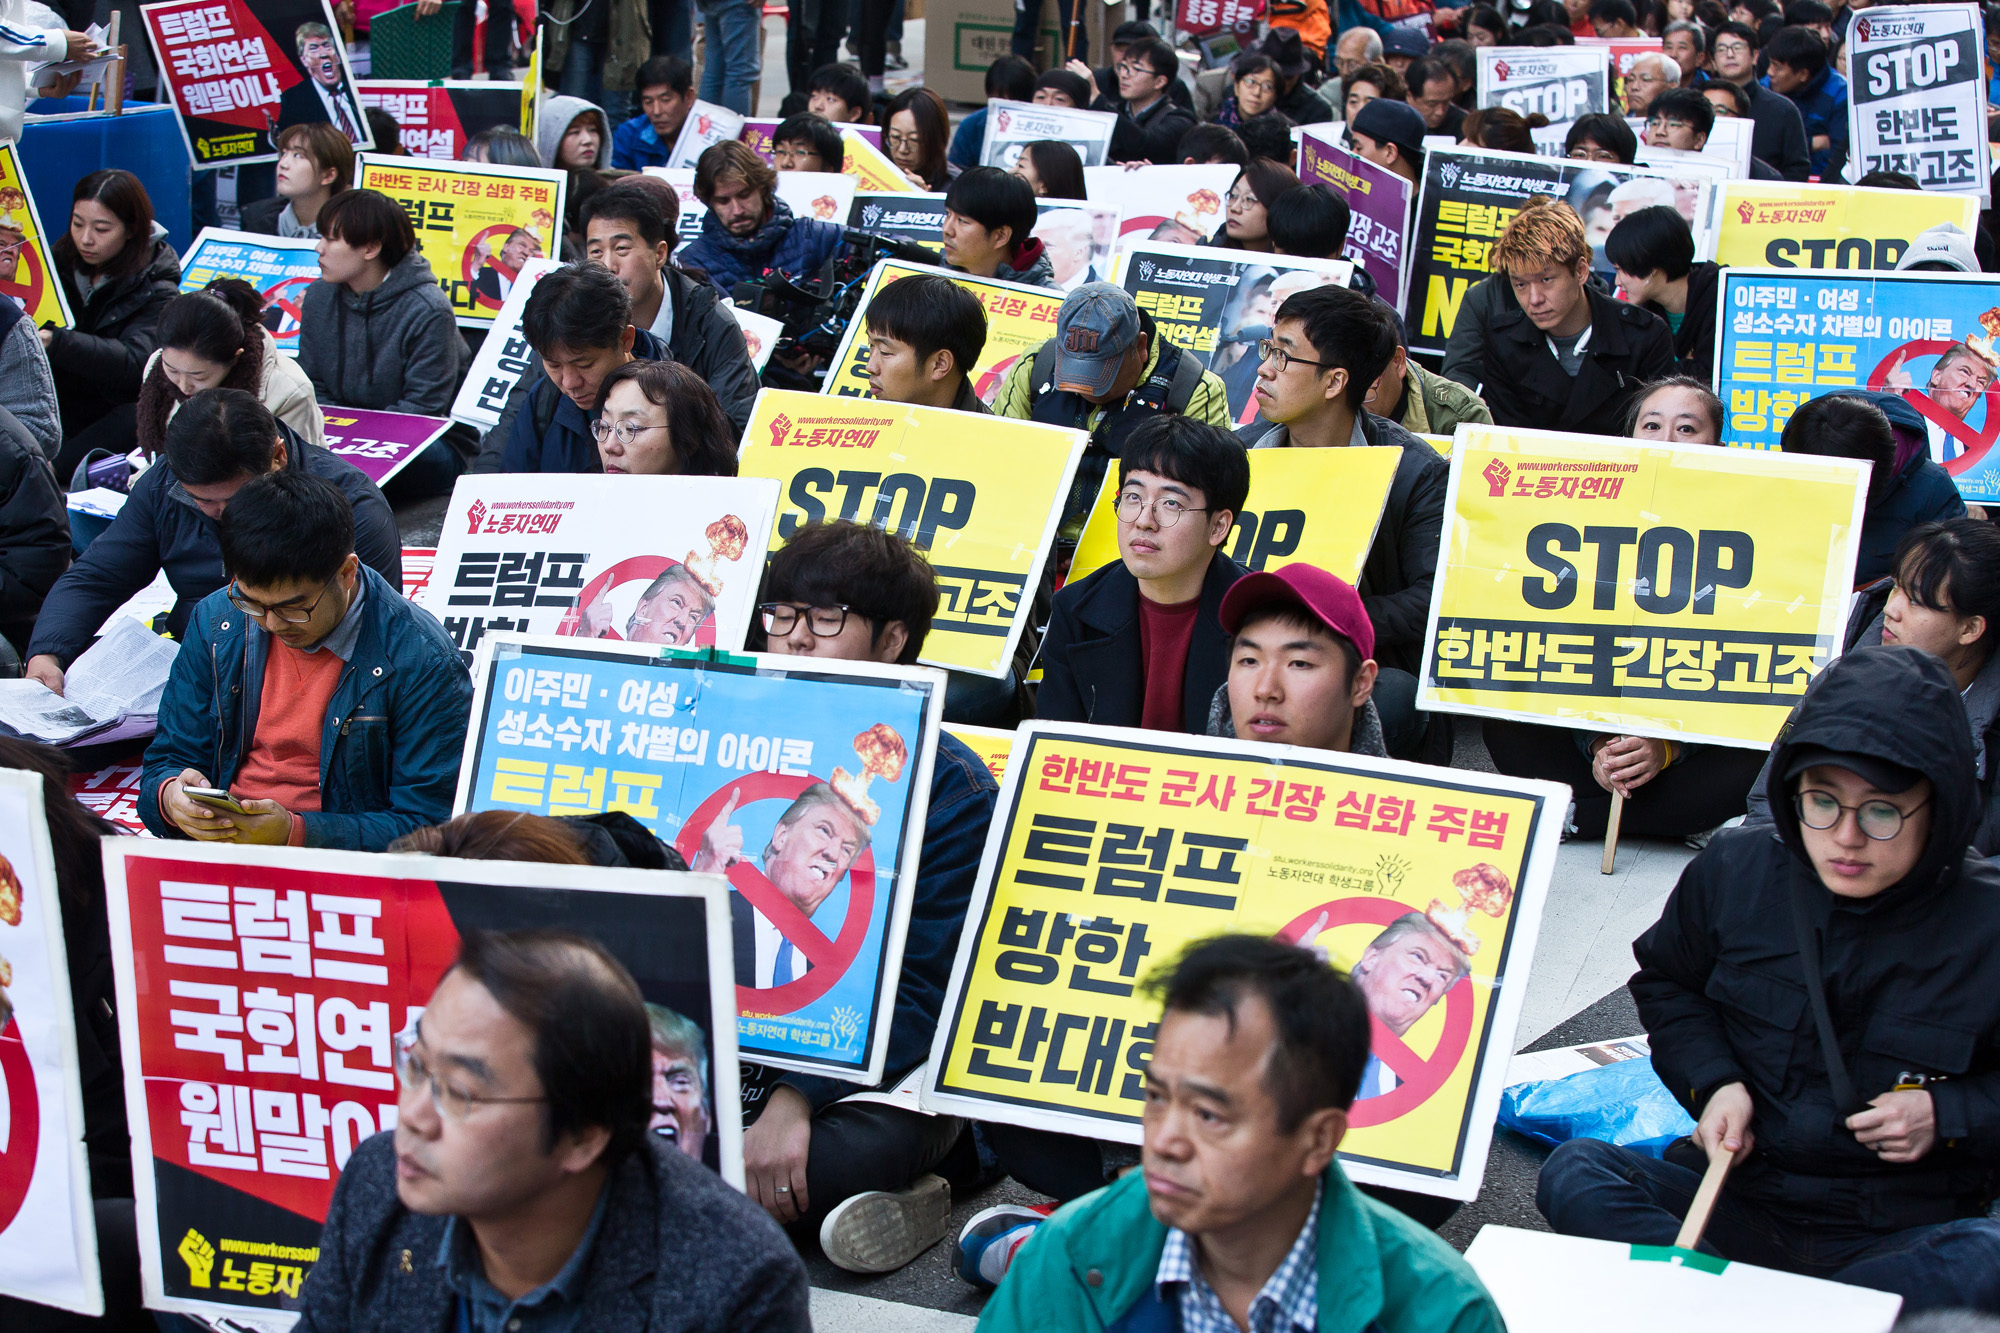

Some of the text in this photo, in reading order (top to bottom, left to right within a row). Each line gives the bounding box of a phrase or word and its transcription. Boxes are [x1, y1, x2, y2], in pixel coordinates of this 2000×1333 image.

[158, 5, 235, 46] 트럼프
[1870, 22, 1925, 37] 노동자연대
[169, 36, 271, 79] 국회연설
[1867, 39, 1960, 96] STOP
[182, 72, 282, 115] 웬말이냐
[1501, 79, 1588, 122] STOP
[1875, 106, 1960, 146] 한반도
[368, 172, 549, 203] 한반도 군사 긴장 심화 주범
[399, 198, 455, 232] 럼프
[1755, 209, 1827, 224] 노동자연대
[988, 294, 1028, 317] 긴장
[1135, 290, 1205, 322] 트럼프
[1421, 274, 1481, 340] N
[1734, 286, 1797, 309] 이주민
[1817, 288, 1860, 312] 여성
[1733, 312, 1953, 342] 성소수자 차별의 아이콘
[1731, 340, 1857, 386] 트럼프
[788, 427, 881, 450] 노동자연대
[796, 415, 894, 427] www.workerssolidarity.org
[324, 434, 410, 459] 고조
[1516, 461, 1639, 474] www.workerssolidarity.org
[491, 500, 575, 511] www.workerssolidarity.org
[1511, 476, 1625, 500] 노동자연대
[482, 514, 563, 535] 노동자연대
[777, 466, 977, 552] STOP
[447, 551, 591, 608] 트럼프
[1521, 522, 1755, 616] STOP
[934, 575, 1022, 628] 고조
[1434, 627, 1829, 697] 한반도 긴장고조
[503, 667, 592, 709] 이주민
[617, 678, 679, 718] 여성
[496, 709, 814, 778] 성소수자 차별의 아이콘
[1039, 753, 1152, 802] 한반도
[1159, 768, 1237, 812] 군사
[1245, 776, 1328, 822] 긴장
[1335, 792, 1418, 838] 심화
[1427, 805, 1511, 850] 주범
[1013, 813, 1249, 911] 트럼프
[1266, 866, 1375, 893] 노동자연대 학생그룹
[1272, 855, 1375, 877] stu.workerssolidarity.org
[159, 880, 389, 986] 트럼프
[994, 906, 1152, 998] 방한
[169, 979, 412, 1092] 국회연
[737, 1020, 832, 1048] 노동자연대 학생그룹
[741, 1009, 831, 1031] stu.workerssolidarity.org
[179, 1081, 399, 1181] 웬말이
[219, 1238, 321, 1263] www.workerssoli
[218, 1258, 305, 1299] 노동자
